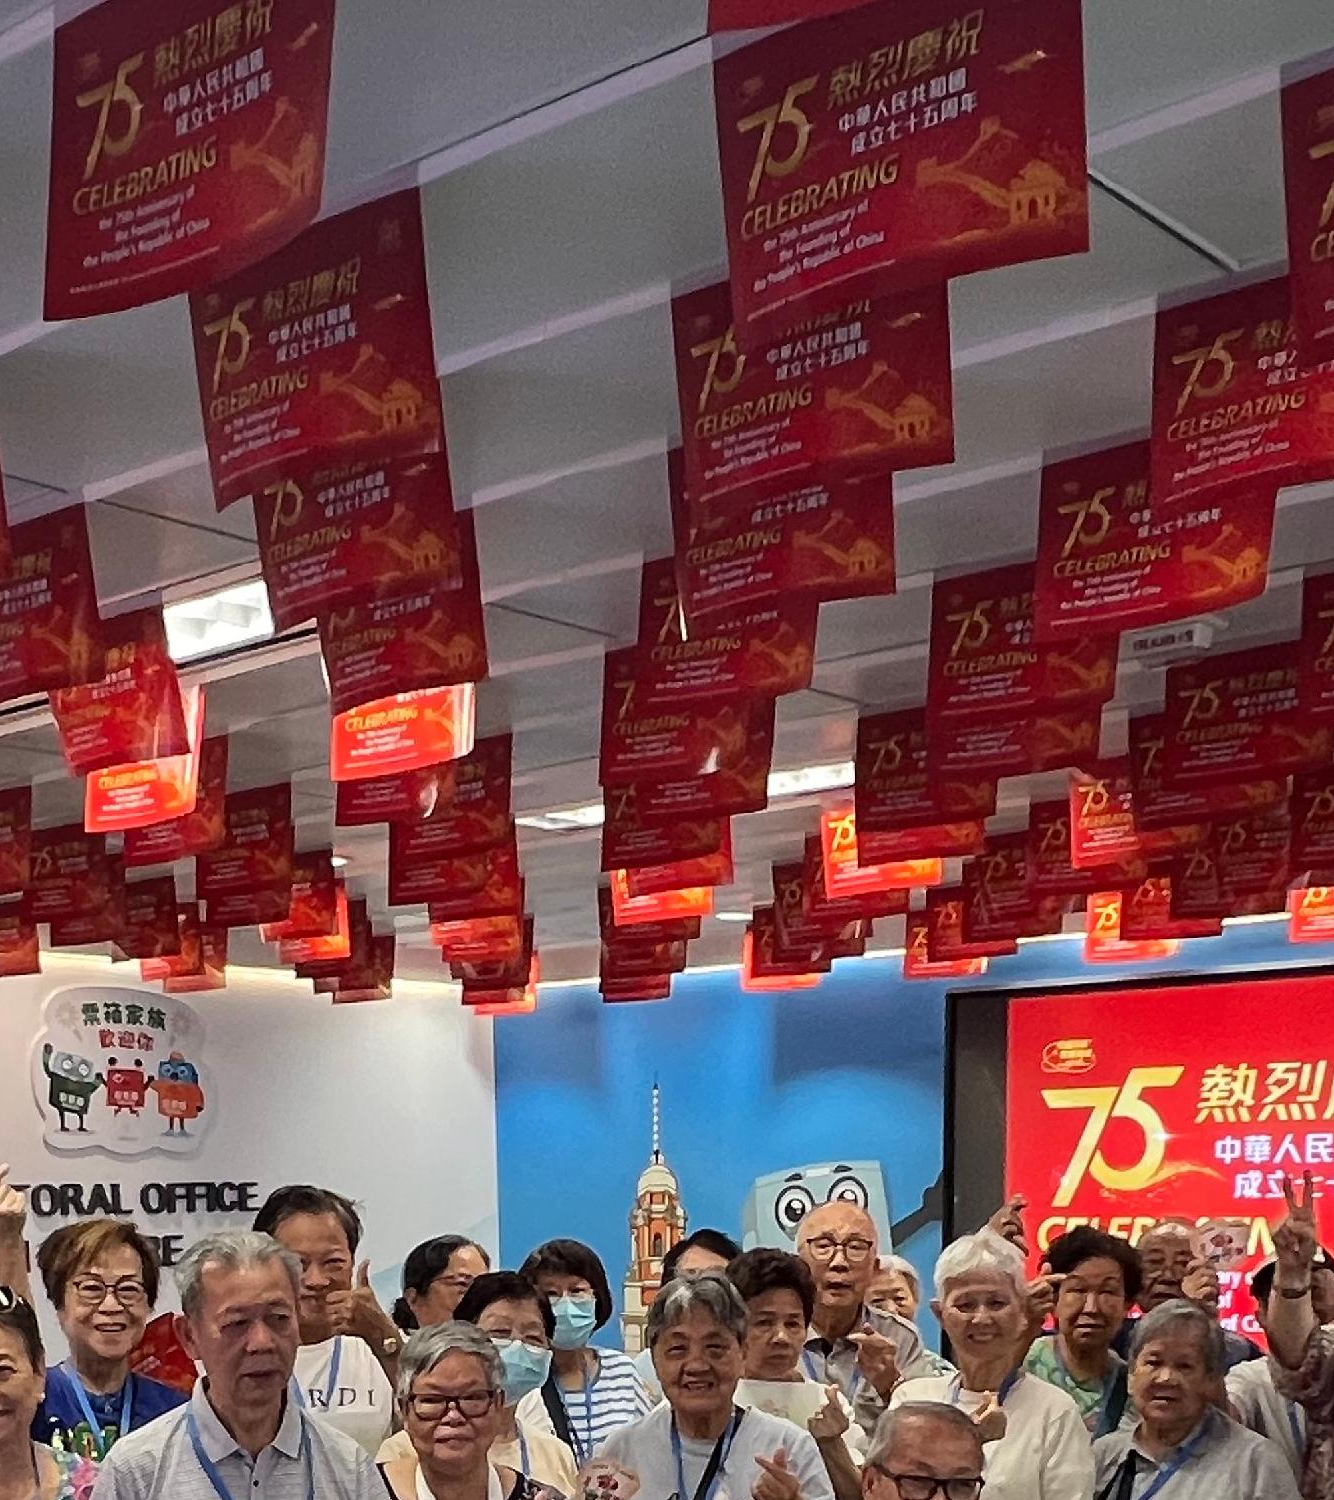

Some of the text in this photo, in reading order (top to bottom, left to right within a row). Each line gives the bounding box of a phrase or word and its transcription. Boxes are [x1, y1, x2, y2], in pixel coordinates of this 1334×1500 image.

[163, 48, 265, 112] 中華人民共和國
[827, 8, 986, 110] 熱烈慶祝
[76, 52, 145, 181] 75
[175, 70, 274, 136] 成立七十五周年
[838, 67, 967, 132] 中華人民共和國
[851, 91, 979, 156] 成立七十五周年
[736, 74, 820, 204] 75
[72, 136, 217, 216] CELEBRATING
[740, 153, 900, 241] CELEBRATING
[203, 296, 256, 394] 75
[1171, 328, 1245, 417] 75
[207, 365, 310, 421] CELEBRATING
[694, 382, 813, 440] CELEBRATING
[1166, 387, 1307, 441] CELEBRATING
[1057, 486, 1117, 558] 75
[1052, 540, 1172, 579] CELEBRATING
[944, 599, 994, 658] 75
[1041, 1065, 1185, 1209] 75
[140, 1181, 259, 1215] OFFICE
